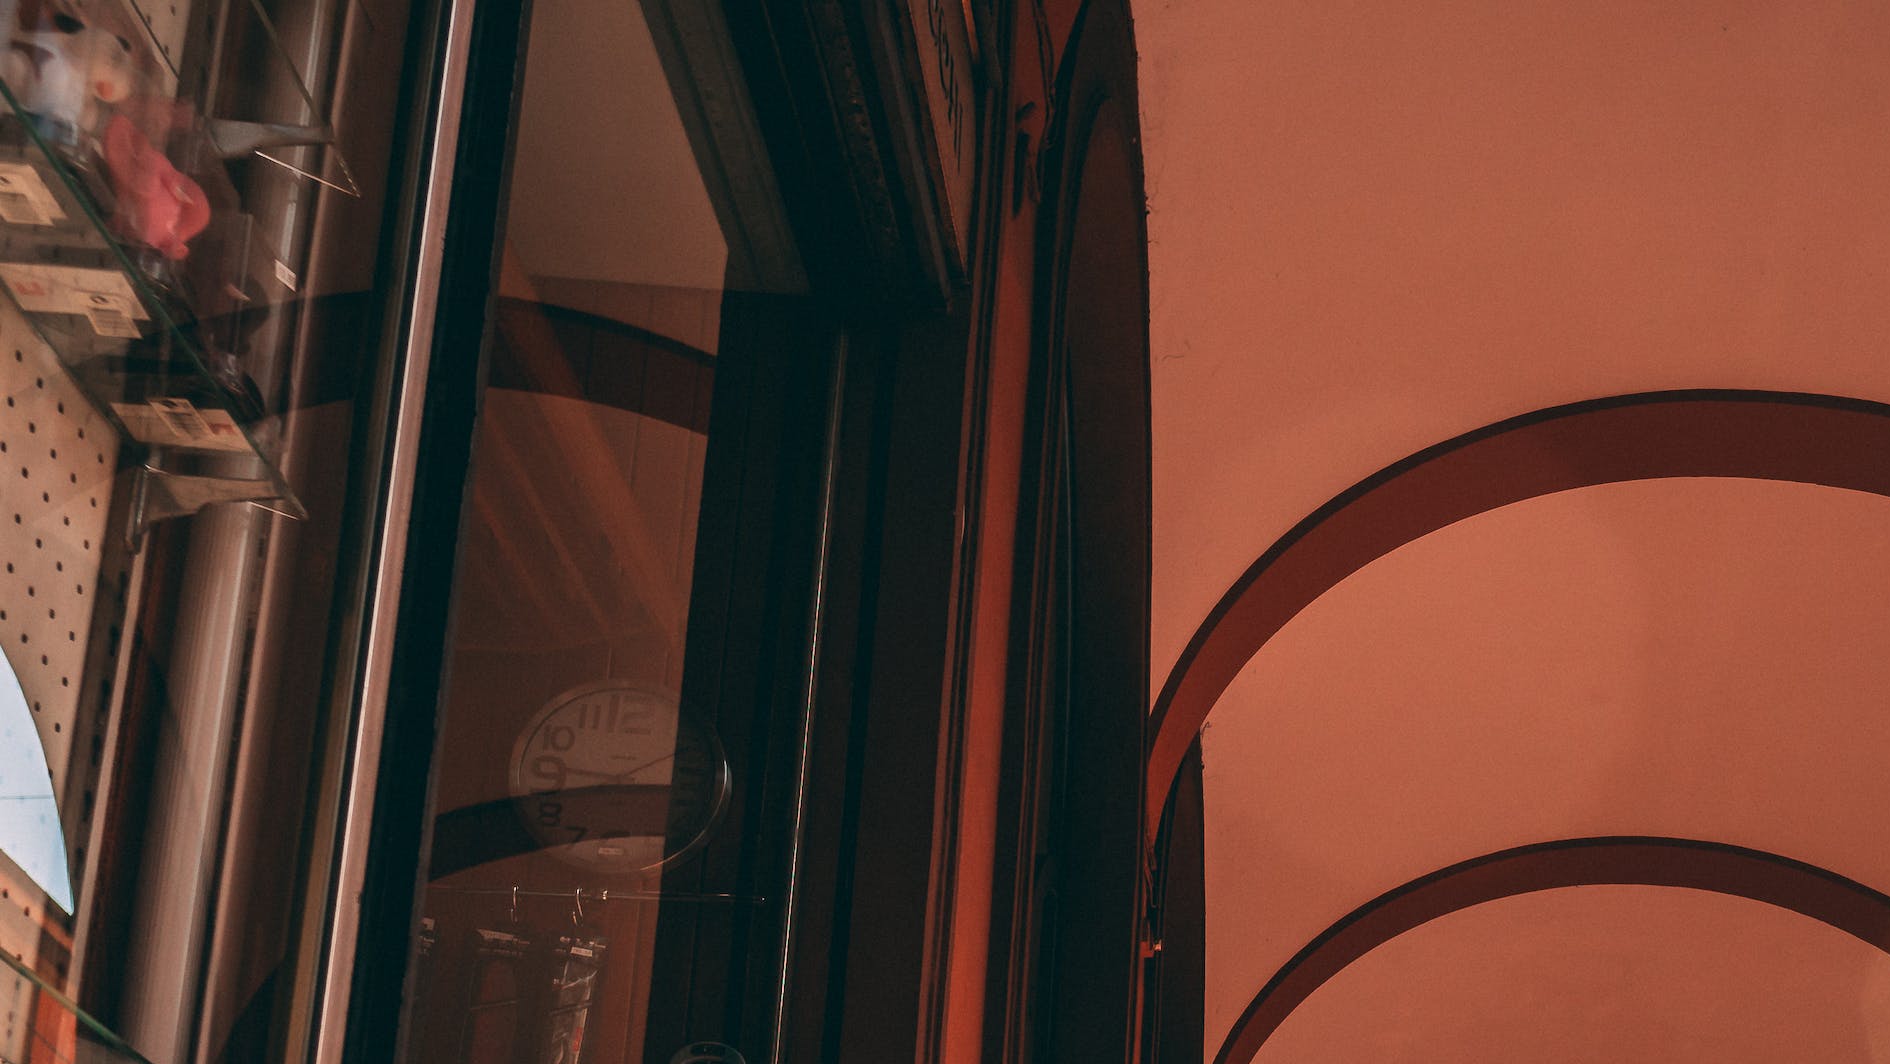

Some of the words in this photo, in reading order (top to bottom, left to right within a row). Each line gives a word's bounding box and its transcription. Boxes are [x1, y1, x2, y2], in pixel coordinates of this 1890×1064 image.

[578, 703, 602, 730] 11
[607, 695, 652, 735] 12
[542, 723, 575, 752] 10
[530, 754, 567, 796] 9
[539, 801, 563, 828] 8
